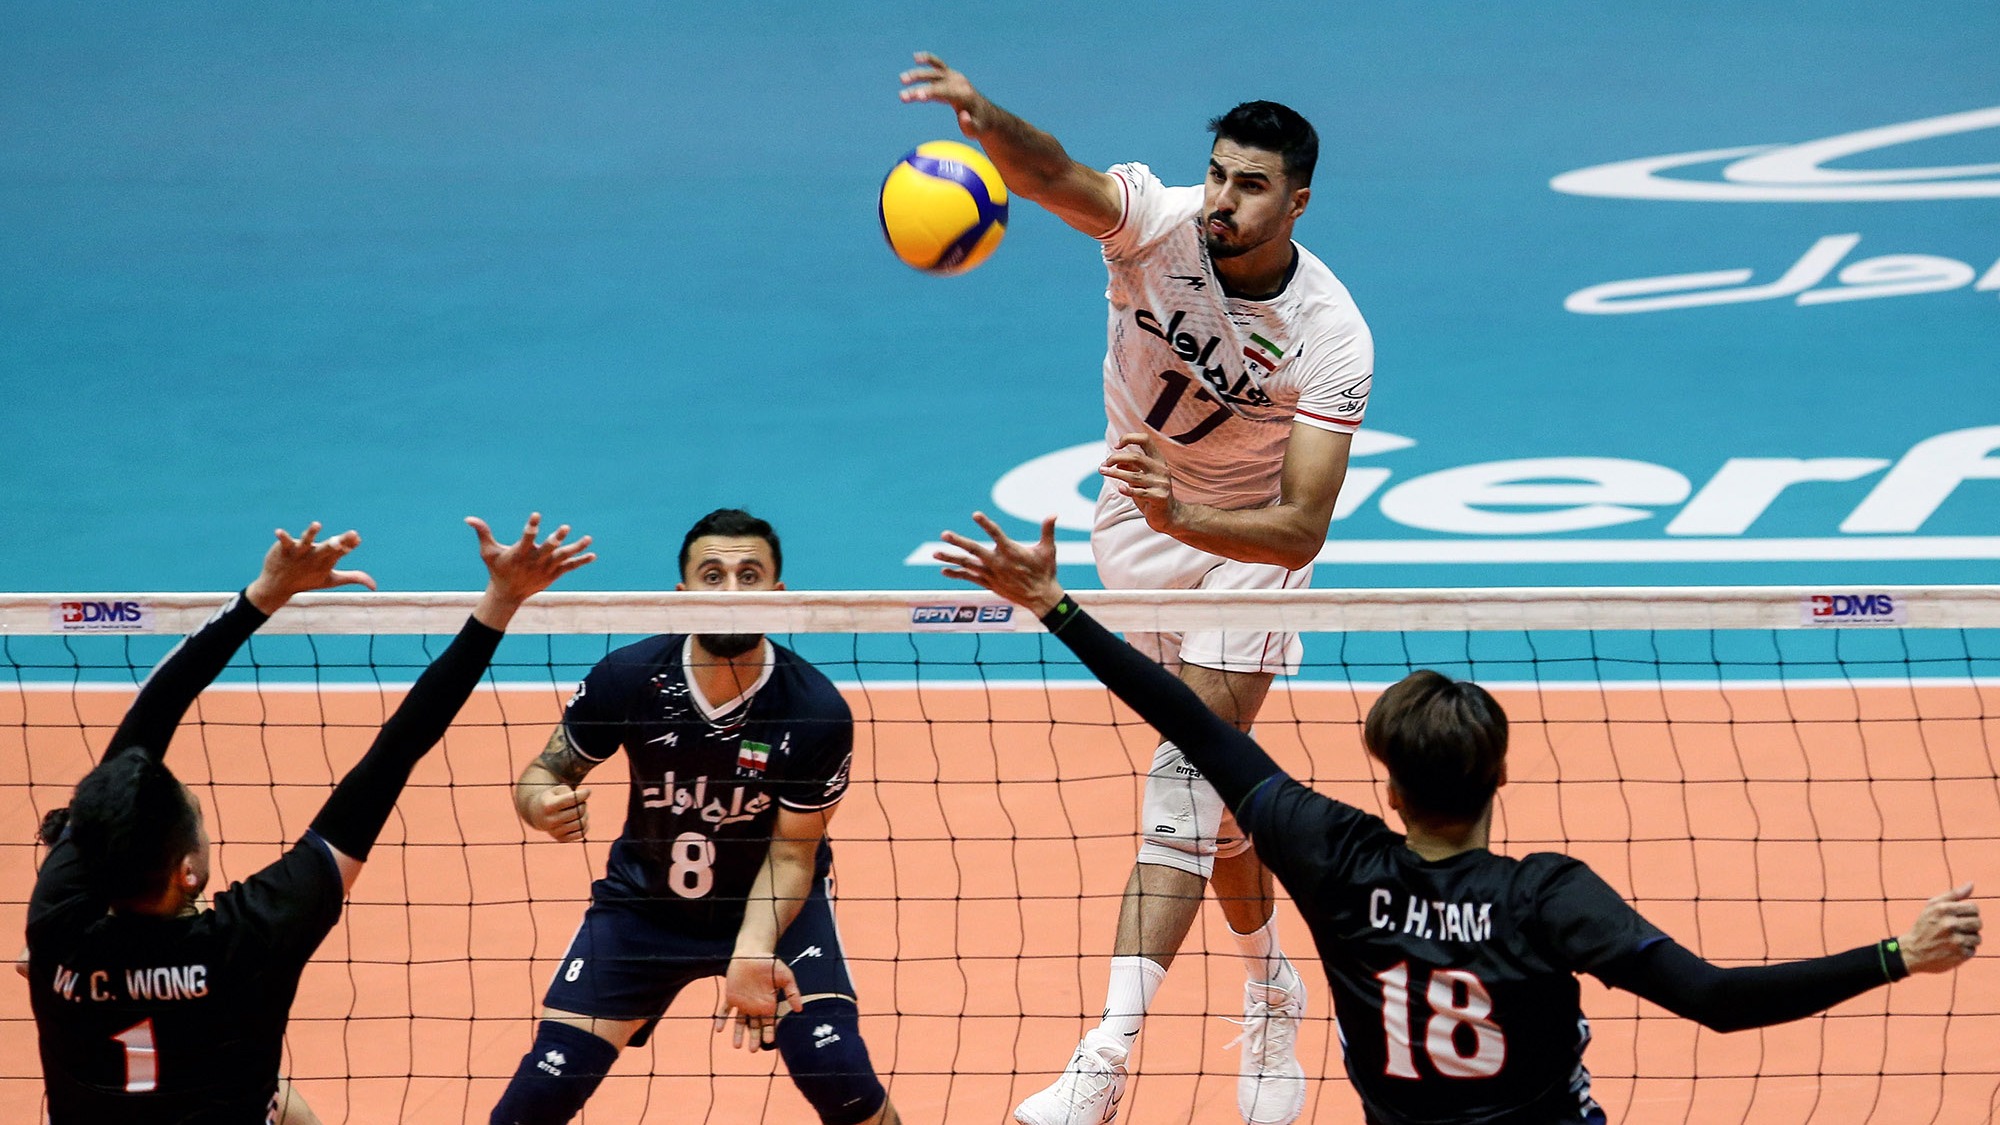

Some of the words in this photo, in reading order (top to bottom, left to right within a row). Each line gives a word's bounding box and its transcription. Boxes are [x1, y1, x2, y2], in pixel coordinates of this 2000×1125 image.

[1144, 369, 1234, 446] 17
[61, 601, 142, 623] BDMS
[914, 607, 957, 622] PPTV
[982, 606, 1009, 620] 36
[1811, 594, 1894, 617] BDMS
[668, 831, 717, 899] 8
[1369, 887, 1397, 932] C.
[1403, 895, 1433, 940] H.
[1432, 901, 1493, 943] TAM
[53, 964, 81, 1003] W.
[90, 970, 117, 1002] C.
[125, 964, 209, 1001] WONG
[564, 957, 583, 982] 8
[1373, 958, 1508, 1081] 18
[109, 1016, 160, 1093] 1
